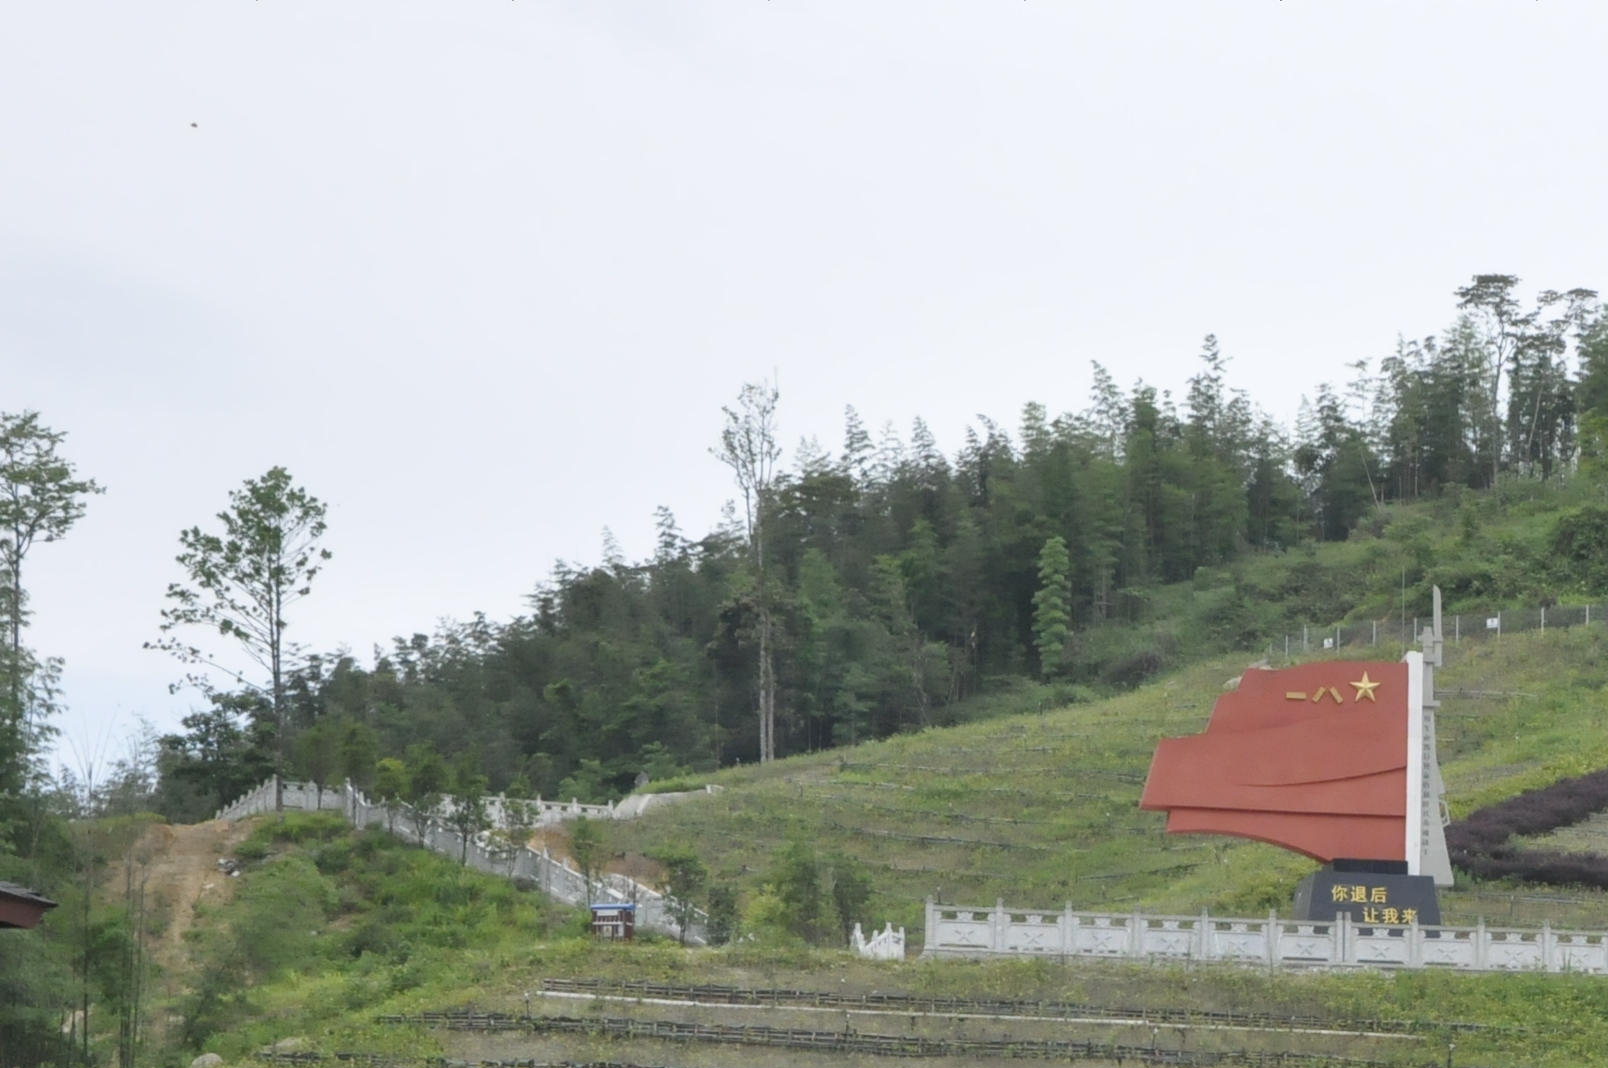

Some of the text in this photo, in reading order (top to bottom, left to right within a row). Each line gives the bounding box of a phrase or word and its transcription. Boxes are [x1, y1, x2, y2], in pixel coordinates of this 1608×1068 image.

[1331, 884, 1387, 904] 你退后
[1362, 906, 1418, 924] 让我来
